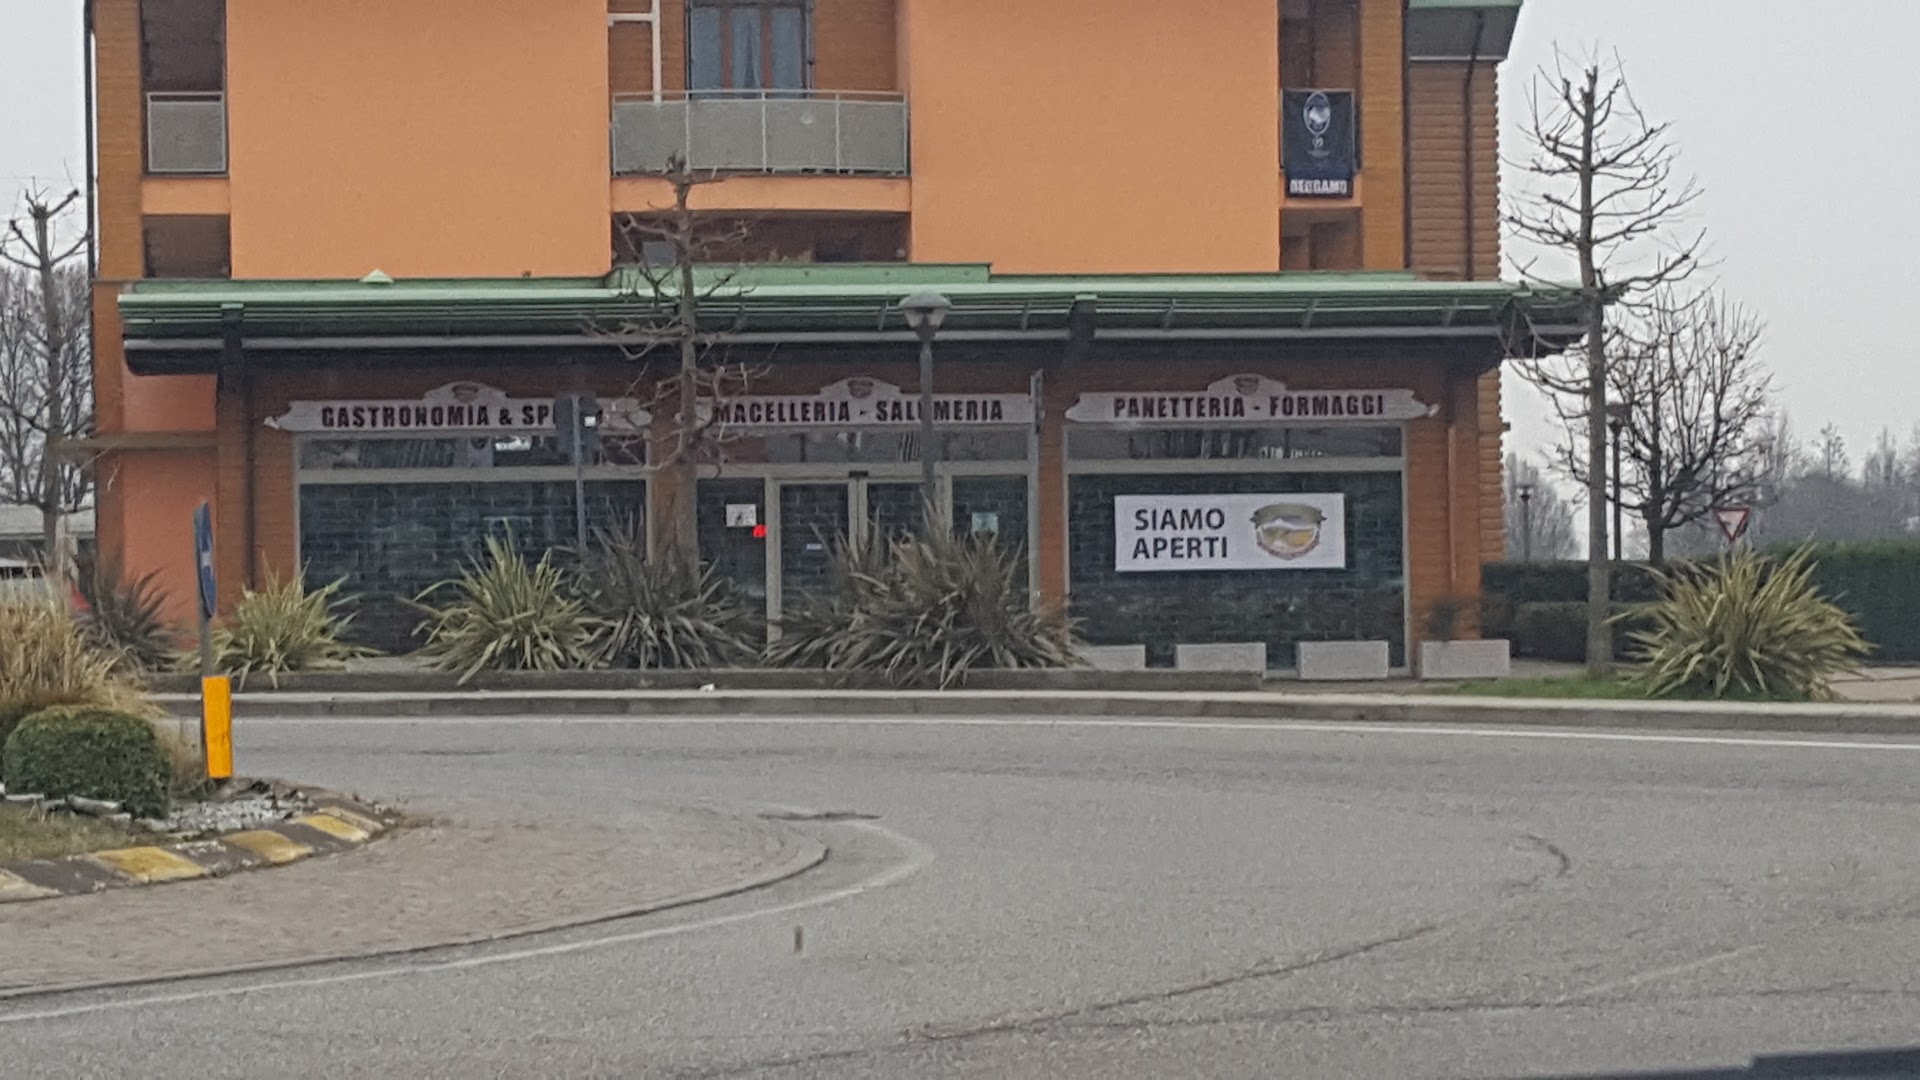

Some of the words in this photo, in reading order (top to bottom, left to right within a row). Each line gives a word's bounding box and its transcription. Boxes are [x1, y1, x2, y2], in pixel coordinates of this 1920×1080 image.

[321, 405, 489, 427] GASTRONOMIA
[499, 408, 513, 425] &
[714, 401, 850, 424] MACELLERIA
[1113, 396, 1245, 418] PANETTERIA
[1269, 394, 1384, 416] FORMAGGI
[1134, 508, 1226, 531] SIAMO
[1132, 537, 1228, 559] APERTI
